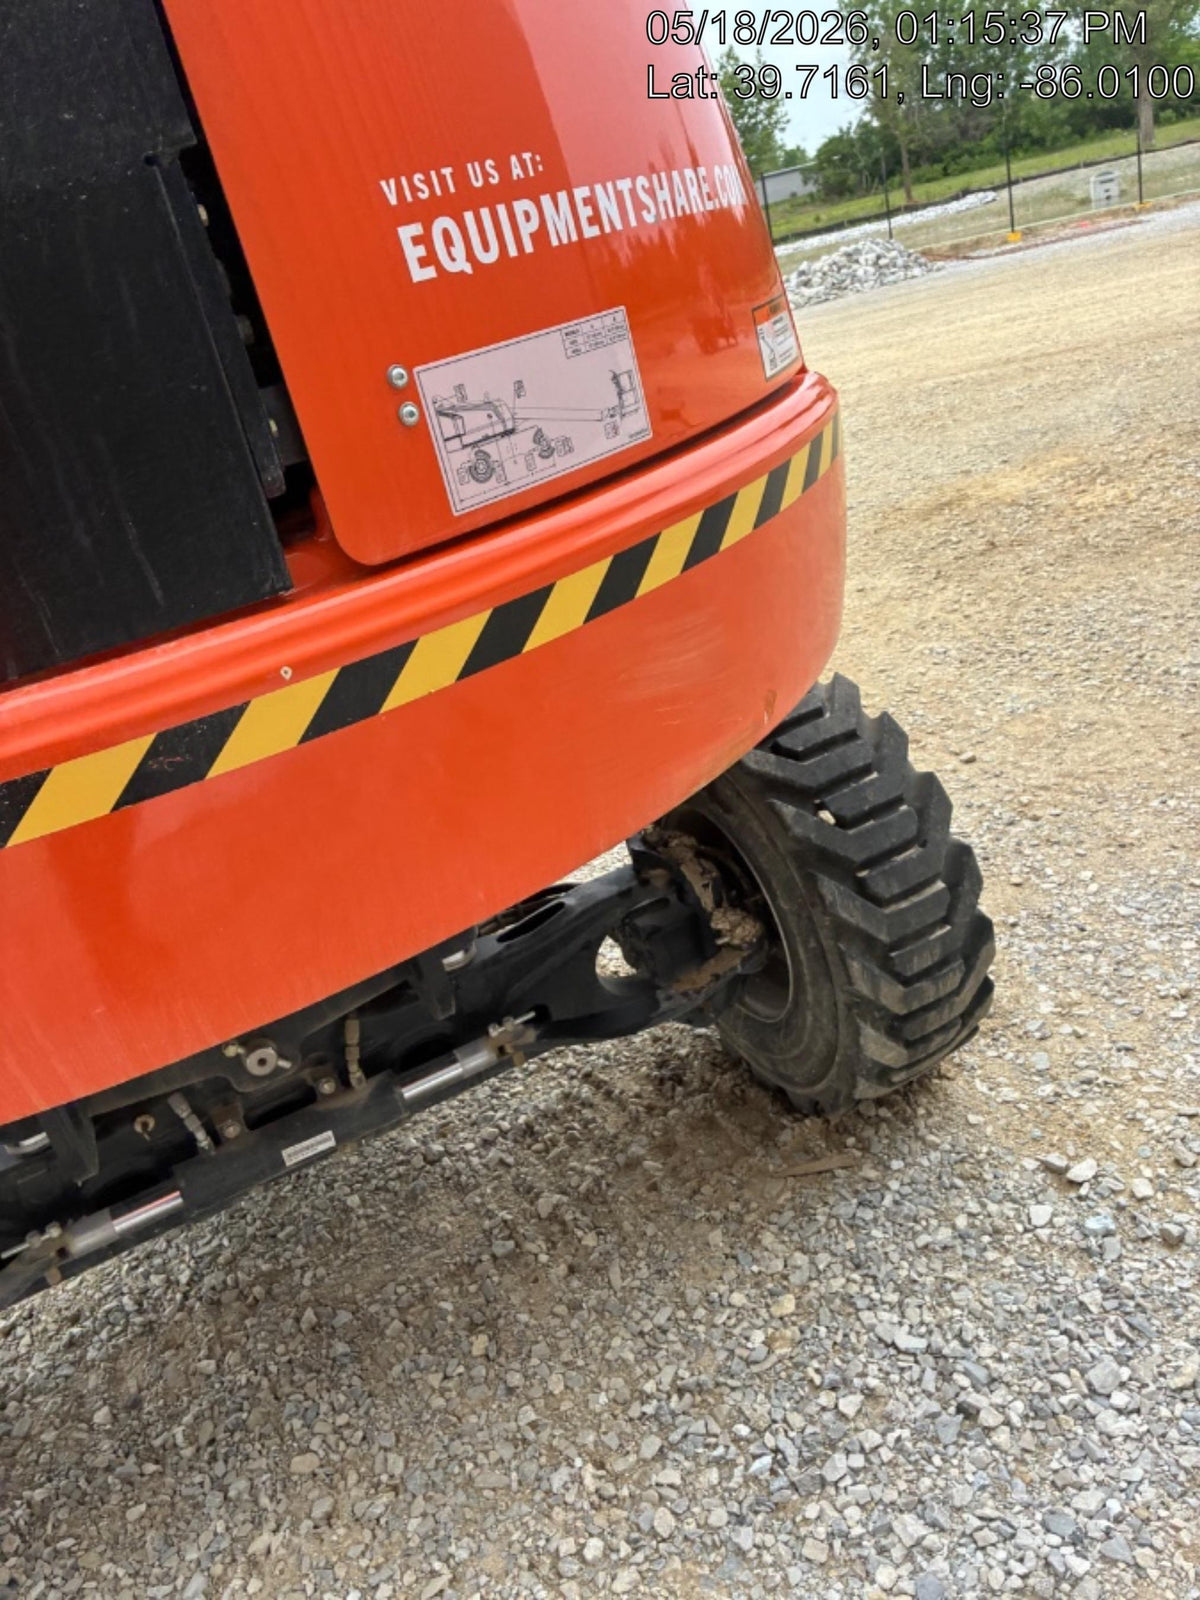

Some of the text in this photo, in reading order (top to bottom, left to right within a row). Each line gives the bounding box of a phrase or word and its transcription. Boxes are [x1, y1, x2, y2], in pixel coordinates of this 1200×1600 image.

[379, 151, 544, 206] VISIT US AT:
